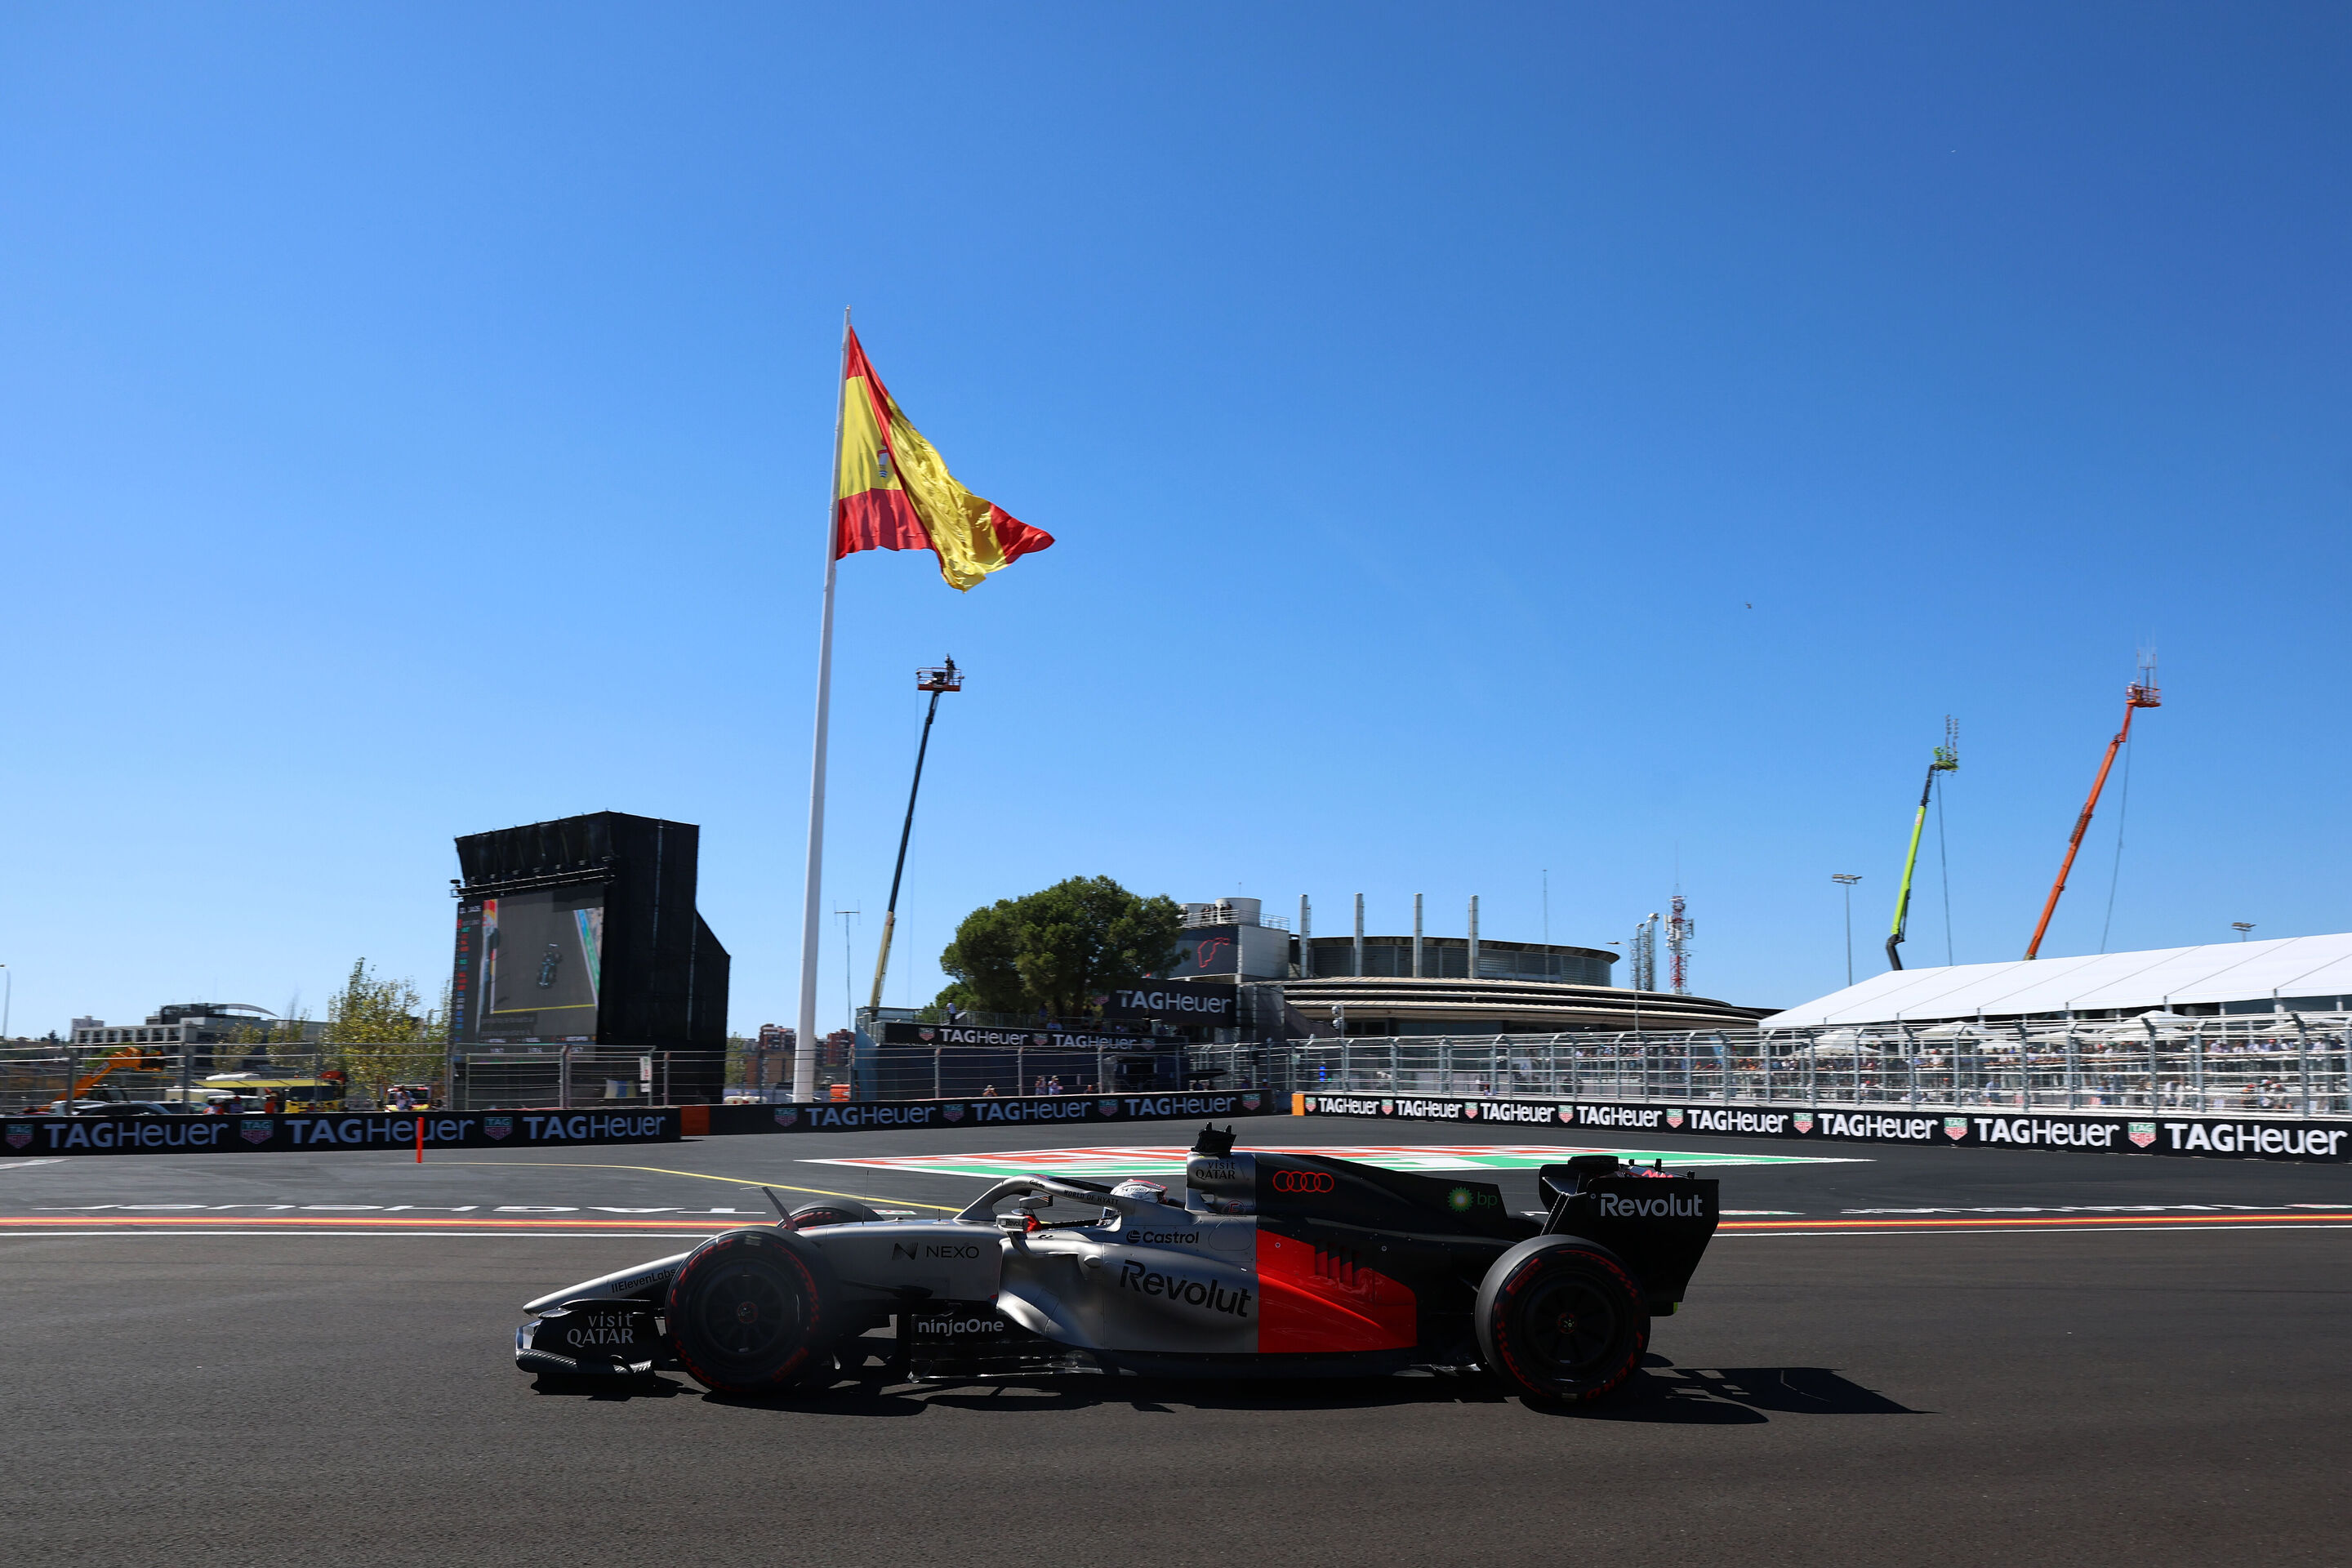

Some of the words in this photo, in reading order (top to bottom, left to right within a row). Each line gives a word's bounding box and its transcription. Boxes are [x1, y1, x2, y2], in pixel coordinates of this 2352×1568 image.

[804, 1106, 937, 1126] TAGHeuer
[970, 1101, 1092, 1121] TAGHeuer
[1124, 1097, 1237, 1116] TAGHeuer
[1317, 1097, 1379, 1115] TAGHeuer
[1395, 1099, 1463, 1119] TAGHeuer
[1480, 1102, 1556, 1123] TAGHeuer
[1575, 1105, 1660, 1128] TAGHeuer
[1686, 1109, 1789, 1134] TAGHeuer
[1817, 1112, 1939, 1139] TAGHeuer
[42, 1121, 229, 1148] TAGHeuer
[284, 1118, 475, 1144] TAGHeuer
[522, 1115, 666, 1139] TAGHeuer
[1973, 1117, 2121, 1147] TAGHeuer
[2163, 1123, 2349, 1156] TAGHeuer
[1196, 1169, 1236, 1180] QATAR
[1208, 1159, 1236, 1170] visit
[1064, 1189, 1085, 1199] WORLD
[1097, 1196, 1119, 1205] HYATT
[1477, 1191, 1498, 1209] bp
[1600, 1192, 1704, 1217] Revolut
[1143, 1231, 1200, 1244] Castrol
[926, 1245, 979, 1259] NEXO
[1120, 1258, 1252, 1318] Revolut
[588, 1311, 634, 1328] visit
[918, 1318, 1004, 1337] ninjaOne
[566, 1328, 635, 1348] QATAR
